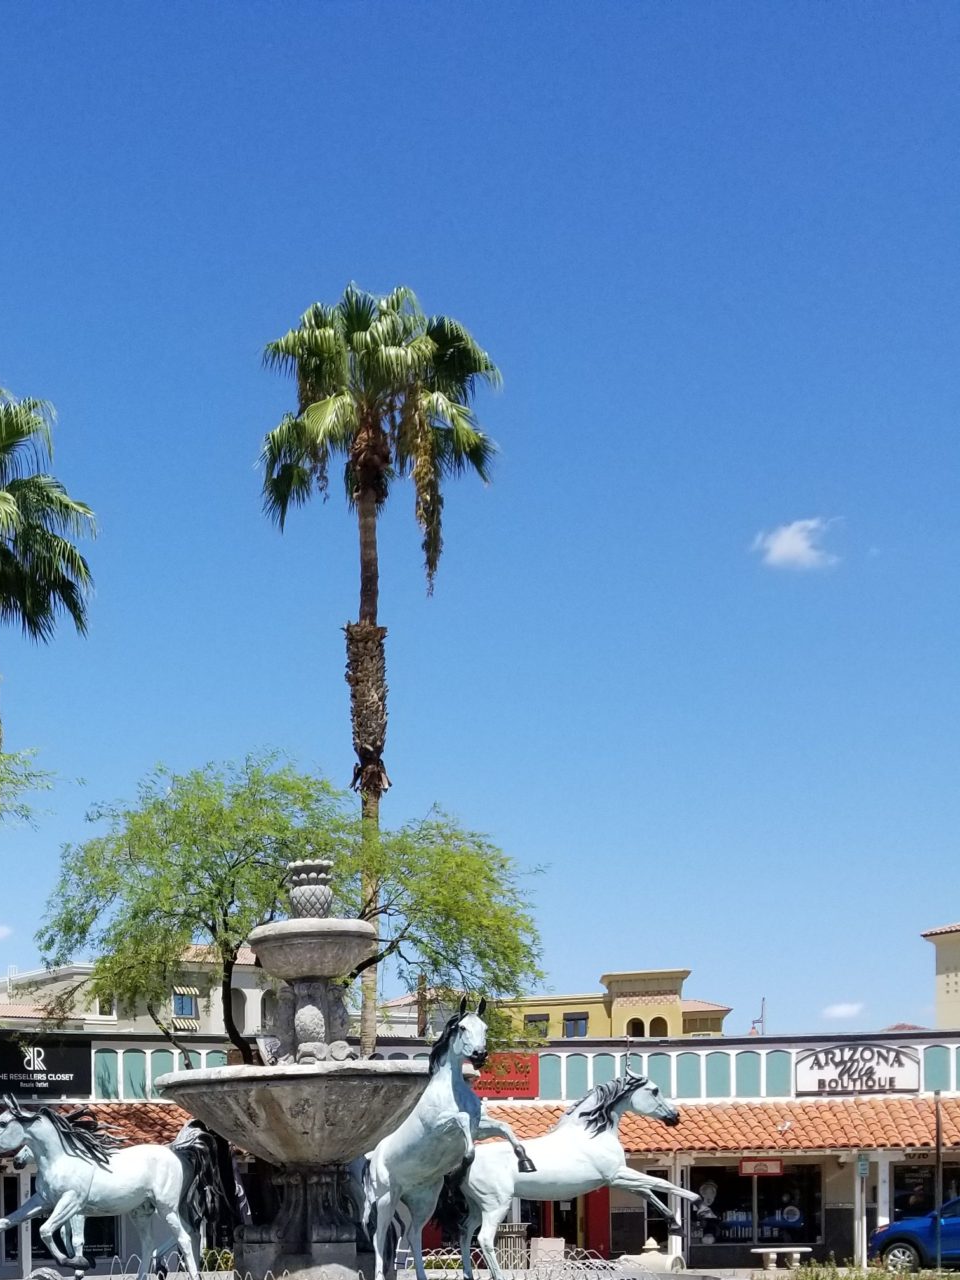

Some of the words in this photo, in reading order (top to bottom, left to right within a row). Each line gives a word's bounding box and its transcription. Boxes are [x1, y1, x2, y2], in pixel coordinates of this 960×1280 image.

[810, 1047, 905, 1070] ARIZONA
[10, 1073, 46, 1081] RESELLERS
[48, 1073, 74, 1081] CLOSET
[514, 1059, 531, 1078] Top
[838, 1060, 876, 1081] Wig
[818, 1077, 896, 1090] BOUTIQUE
